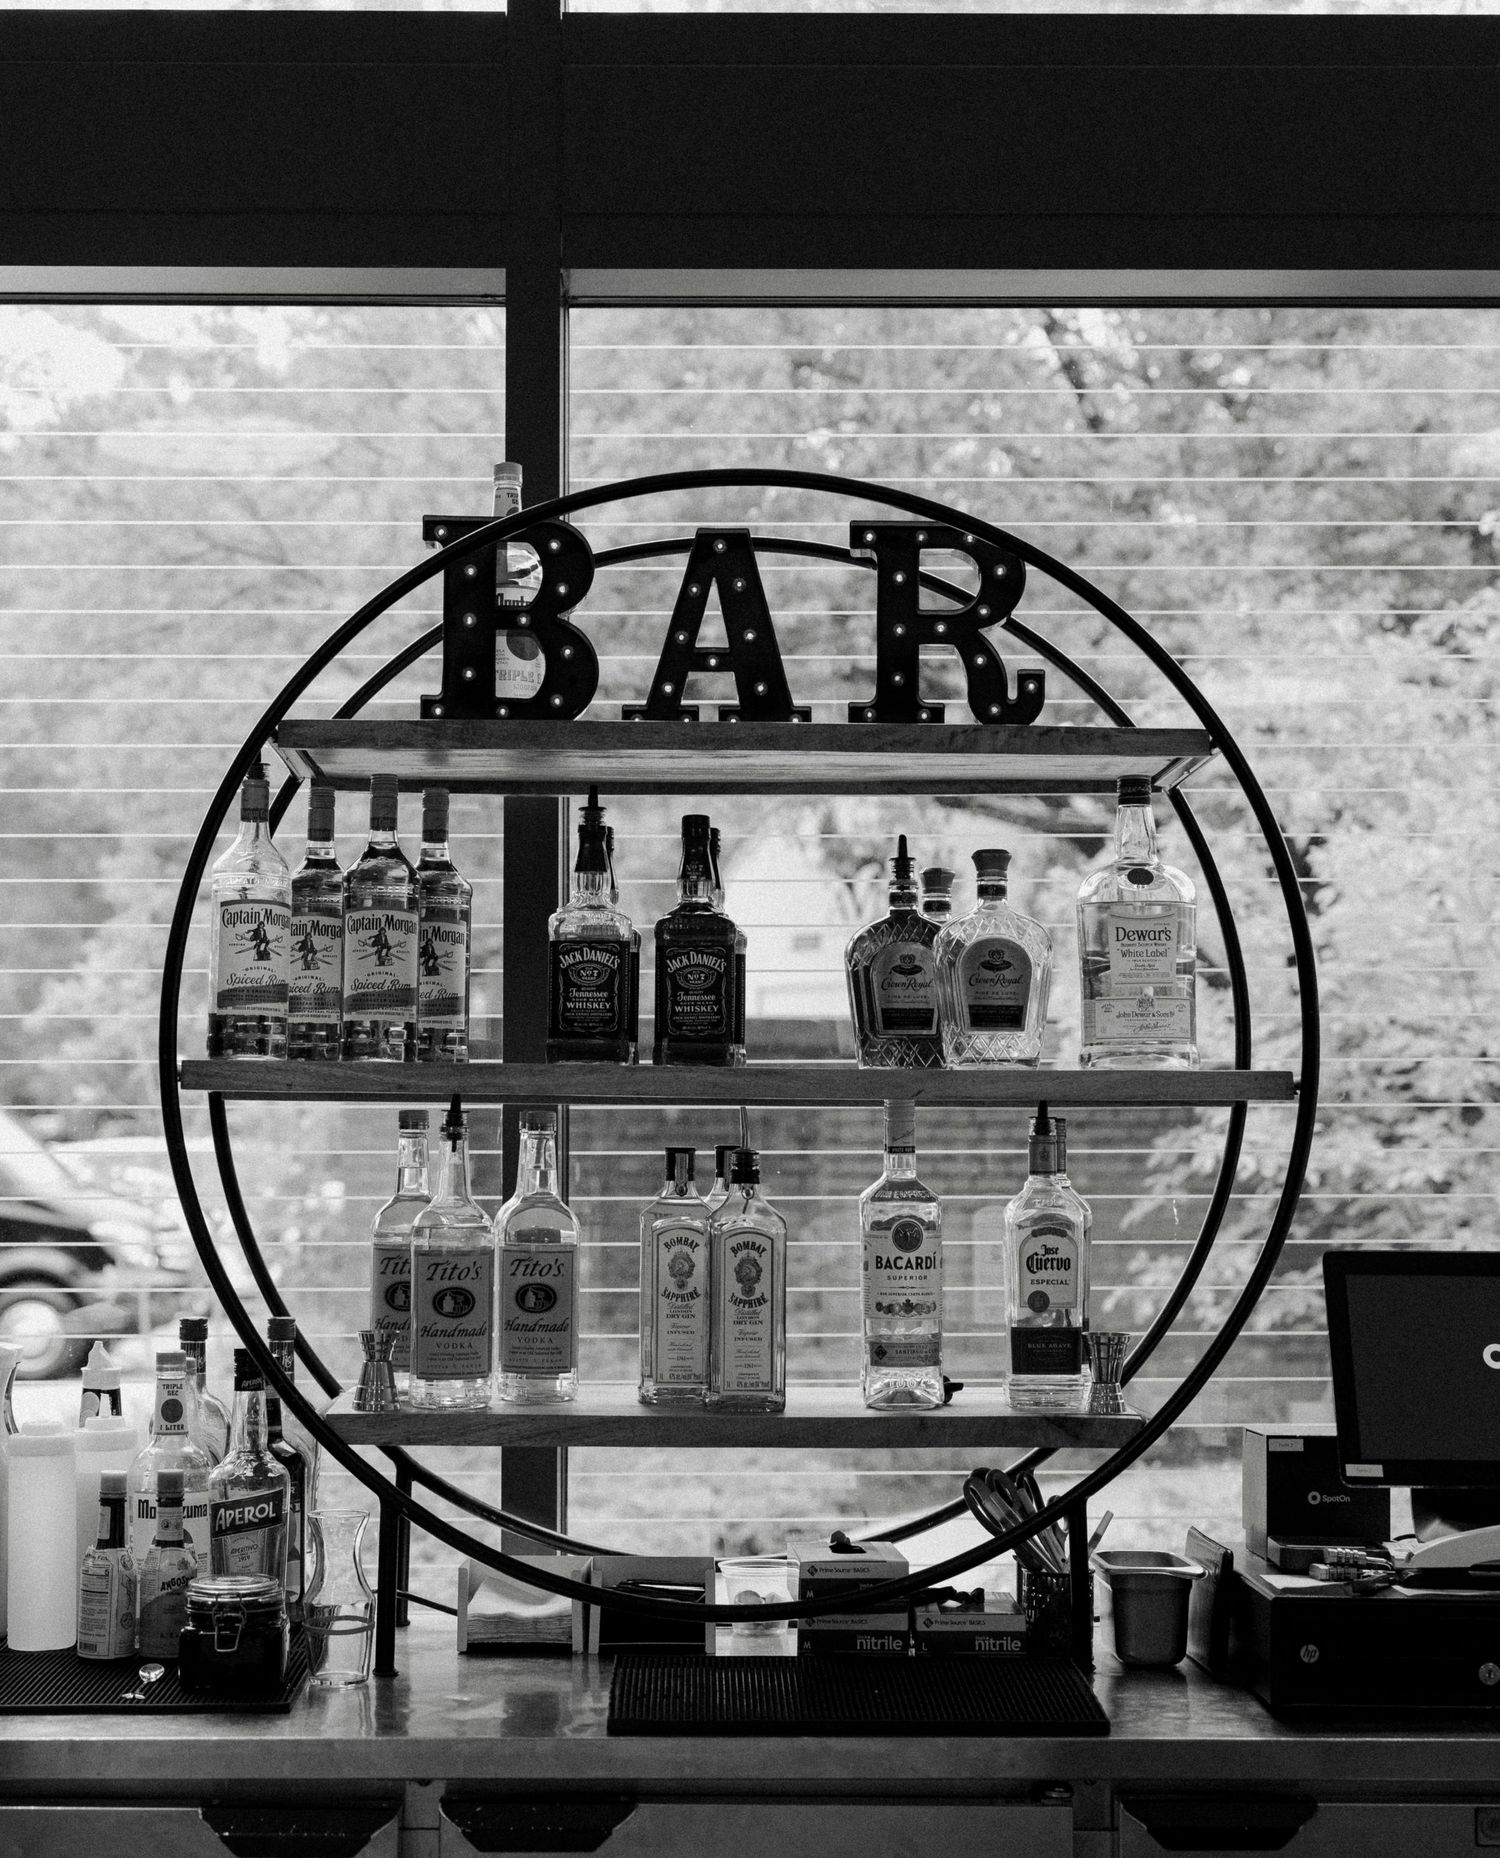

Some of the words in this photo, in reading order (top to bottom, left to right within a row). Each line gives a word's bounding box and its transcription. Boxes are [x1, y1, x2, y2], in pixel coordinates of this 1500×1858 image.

[421, 514, 1046, 726] BAR
[496, 669, 535, 683] RIPLE
[222, 907, 260, 929] Captain
[346, 913, 381, 935] Captain
[308, 919, 342, 940] Morga
[428, 925, 465, 946] Morgan
[1114, 925, 1172, 942] Dewar's
[559, 950, 583, 969] JACK
[583, 947, 621, 970] DANIEL'S
[666, 955, 690, 973] JACK
[689, 951, 727, 974] DANIEL'S
[226, 973, 265, 987] Spiced
[350, 978, 387, 992] Spiced
[387, 979, 412, 992] Rum
[880, 977, 907, 991] Crown
[906, 976, 934, 992] Royal
[969, 973, 998, 987] Crown
[995, 974, 1023, 989] Royal
[313, 982, 341, 996] Rum
[433, 988, 460, 1001] Rum
[568, 987, 609, 998] Tennessee
[677, 991, 716, 1002] Tennessee
[664, 1236, 700, 1253] BOMBAY
[730, 1240, 767, 1258] BOMBAY
[1040, 1244, 1060, 1257] Jose
[380, 1255, 411, 1275] Tit
[509, 1256, 565, 1278] Tito's
[875, 1251, 937, 1271] BACARDÍ
[1026, 1251, 1071, 1274] Cuervo
[426, 1260, 483, 1281] Tito's
[1030, 1278, 1070, 1286] ESPECIAL
[661, 1286, 702, 1303] SAPPHIRE
[728, 1292, 770, 1309] SAPPHIRE
[375, 1315, 411, 1330] Hand
[420, 1319, 488, 1338] Handmade
[504, 1316, 570, 1333] Handmade
[436, 1342, 474, 1350] VODKA
[517, 1336, 554, 1344] VODKA
[1322, 1494, 1351, 1504] SpotOn
[215, 1501, 278, 1532] APEROL
[806, 1589, 815, 1599] M
[803, 1641, 812, 1649] M
[856, 1635, 903, 1650] nitrile
[922, 1642, 929, 1651] L
[975, 1636, 1022, 1651] nitrile
[1302, 1644, 1318, 1663] hp
